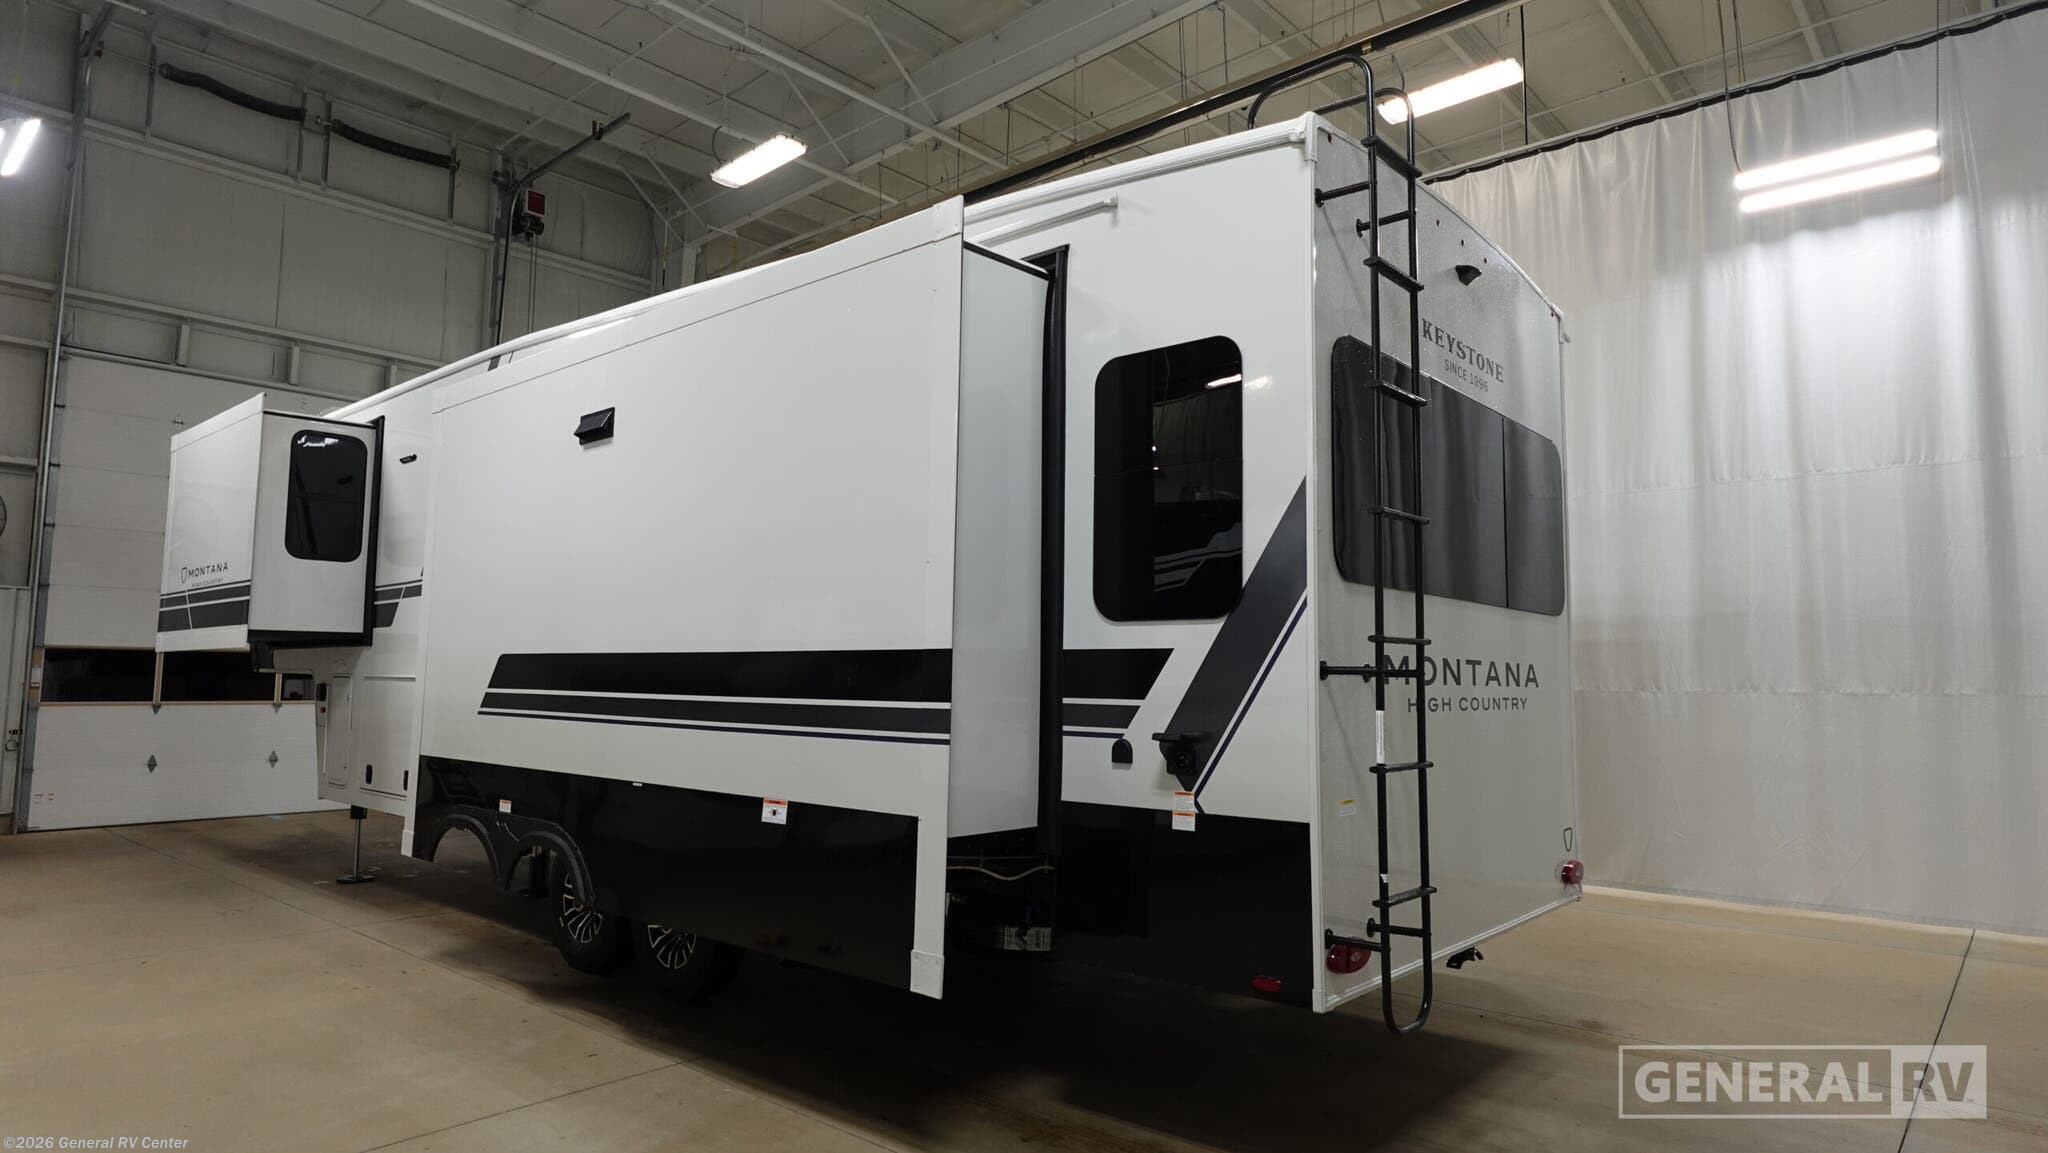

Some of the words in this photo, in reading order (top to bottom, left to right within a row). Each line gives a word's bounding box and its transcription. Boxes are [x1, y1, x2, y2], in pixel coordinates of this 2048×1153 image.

[1422, 318, 1504, 383] KEYSTONE
[1444, 359, 1467, 381] SINCE
[1470, 373, 1488, 392] 1996
[188, 562, 228, 578] MONTANA
[1384, 655, 1539, 688] MONTANA
[1408, 698, 1452, 712] HGH
[1459, 697, 1528, 711] COUNTRY
